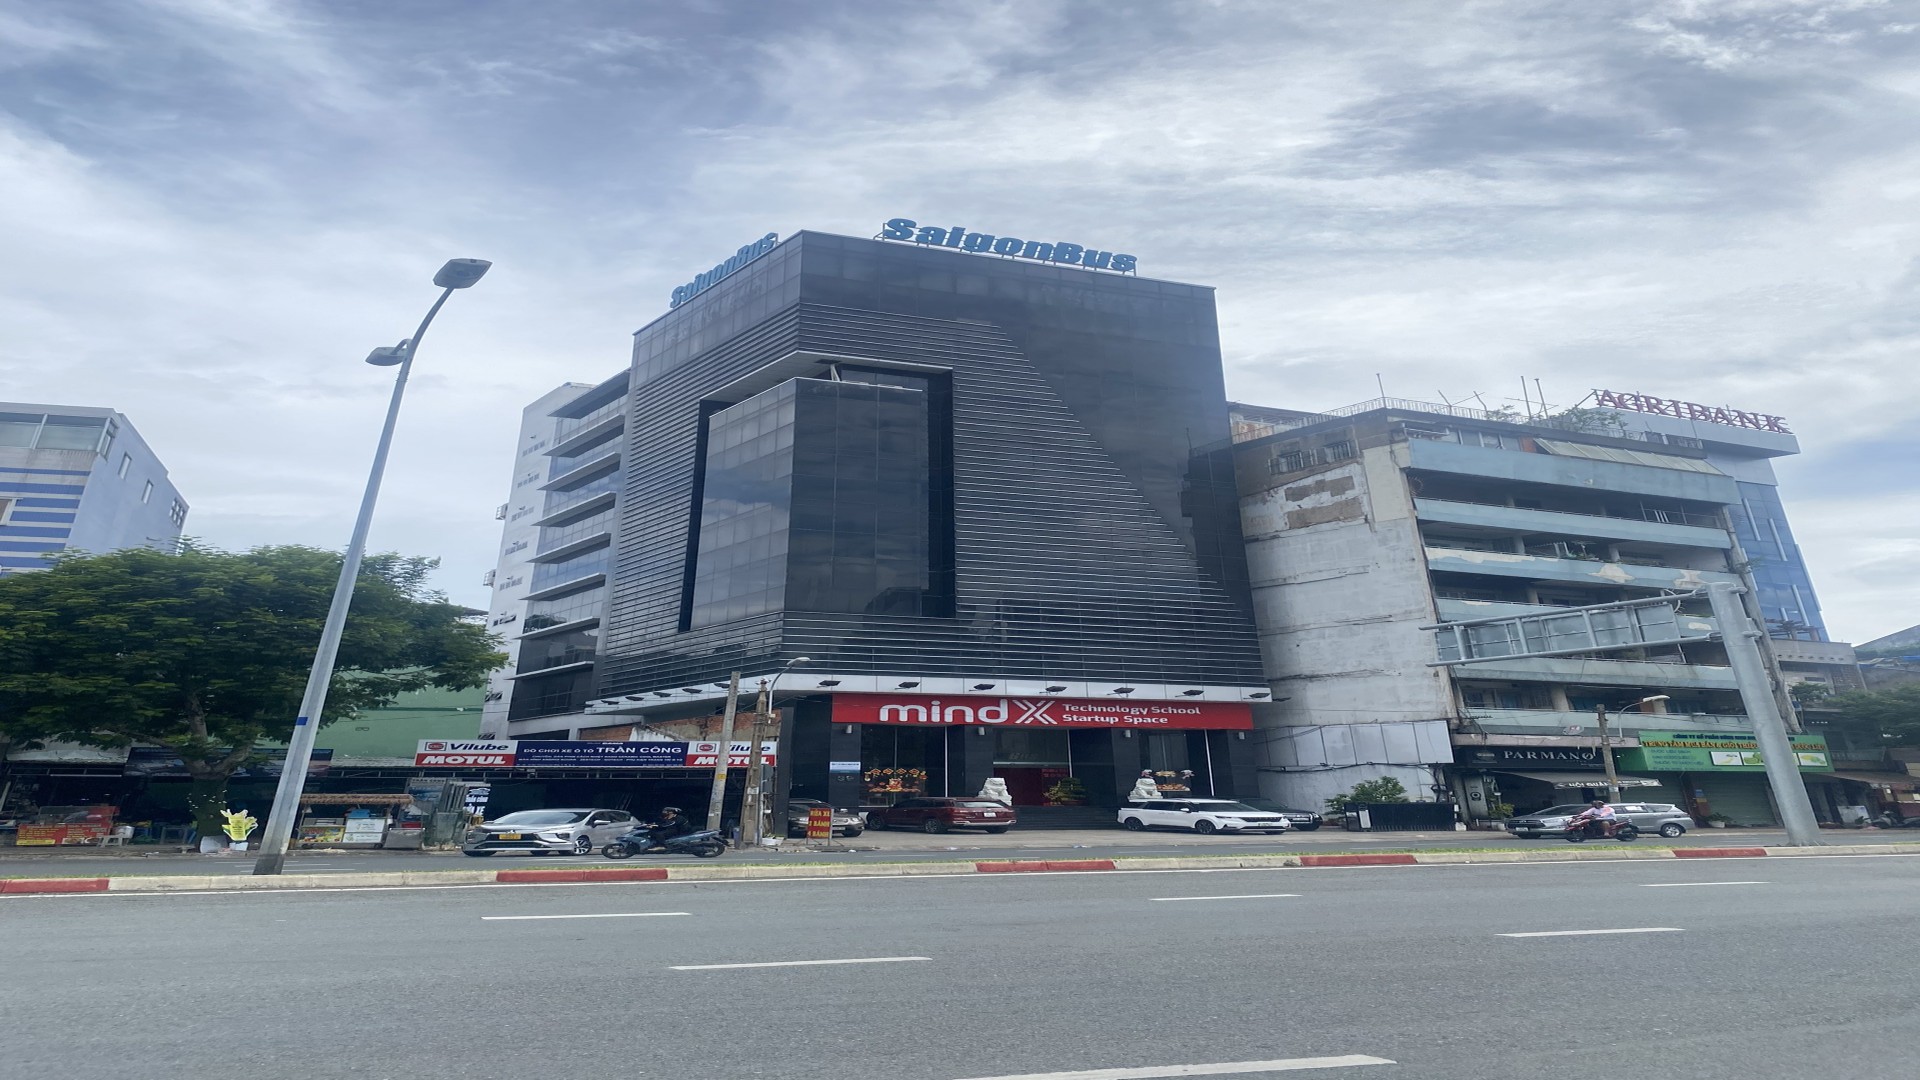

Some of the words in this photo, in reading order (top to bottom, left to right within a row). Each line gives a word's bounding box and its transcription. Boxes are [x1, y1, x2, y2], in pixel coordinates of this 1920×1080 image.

[884, 217, 1138, 272] SaigonBus
[670, 232, 778, 309] SaigonBus
[1597, 389, 1794, 435] AGRIBANK
[1062, 704, 1148, 715] Technology
[1151, 706, 1201, 715] School
[1062, 714, 1119, 724] Startup
[1123, 715, 1169, 724] Space
[450, 743, 509, 751] Vilube
[640, 745, 682, 754] CÔNG
[422, 755, 506, 765] MOTUL
